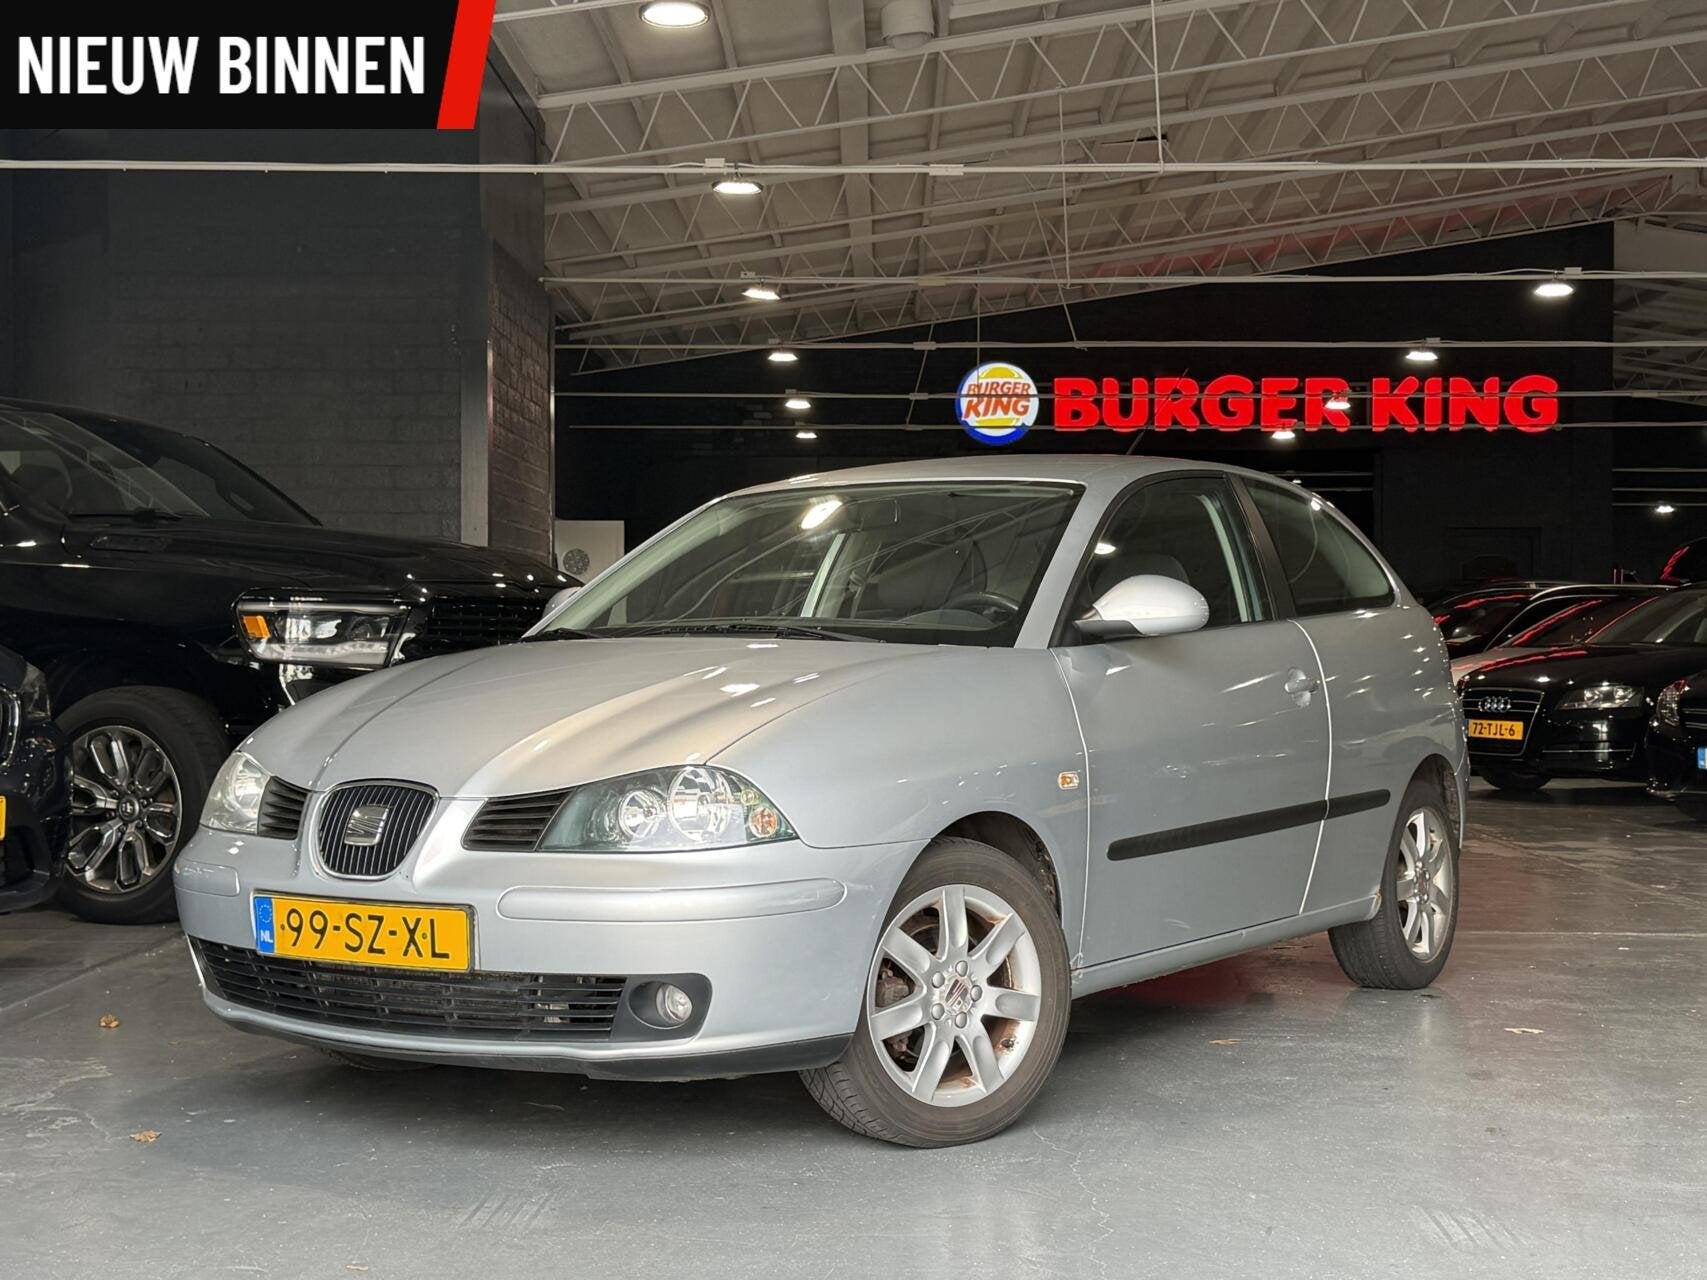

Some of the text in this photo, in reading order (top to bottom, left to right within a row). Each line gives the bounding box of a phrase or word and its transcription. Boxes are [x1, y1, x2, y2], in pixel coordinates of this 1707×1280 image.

[967, 380, 1032, 397] BURGER
[963, 396, 1032, 419] KING
[1053, 374, 1559, 433] BURGER KING
[1472, 721, 1516, 737] 72-TJL-6
[260, 931, 274, 944] NL
[285, 907, 451, 960] 99-SZ-XL
